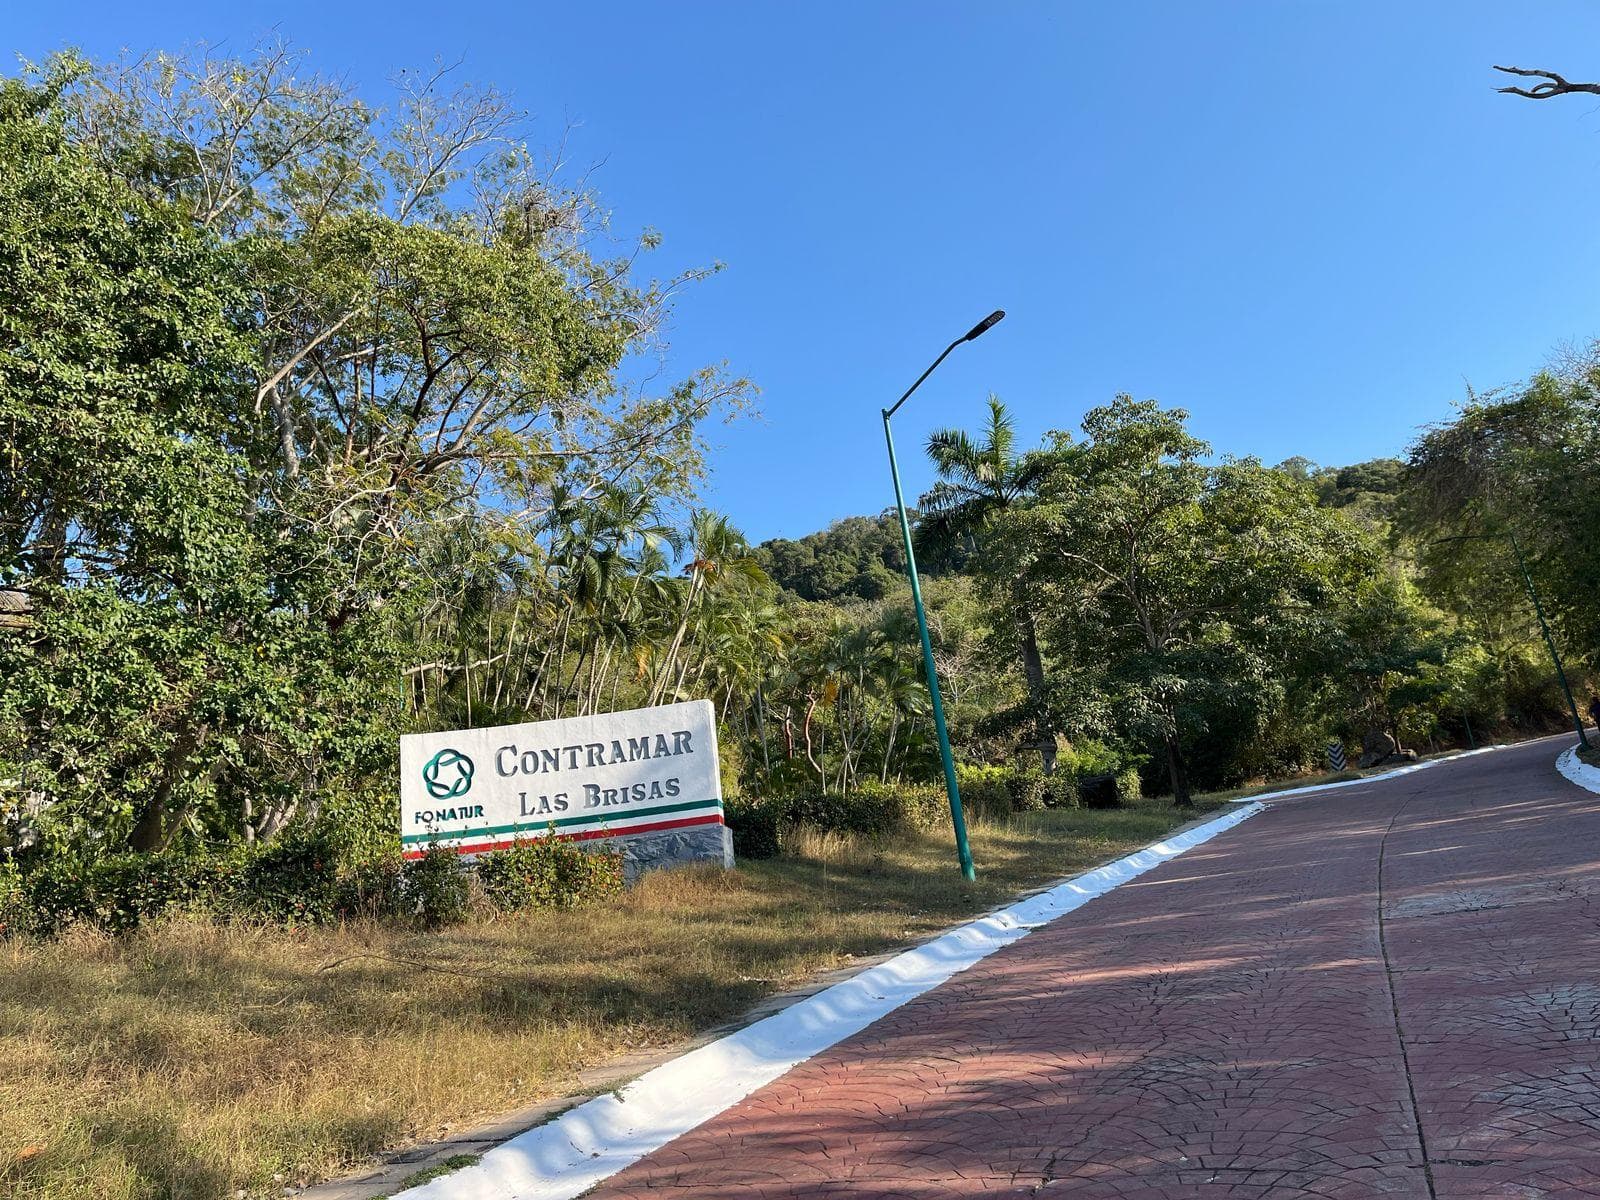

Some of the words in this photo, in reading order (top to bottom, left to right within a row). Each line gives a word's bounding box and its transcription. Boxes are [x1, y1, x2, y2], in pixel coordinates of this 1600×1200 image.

[494, 730, 694, 778] CONTRAMAR
[414, 804, 485, 825] FONATUR
[519, 791, 569, 817] LAS
[582, 777, 681, 809] BRISAS
